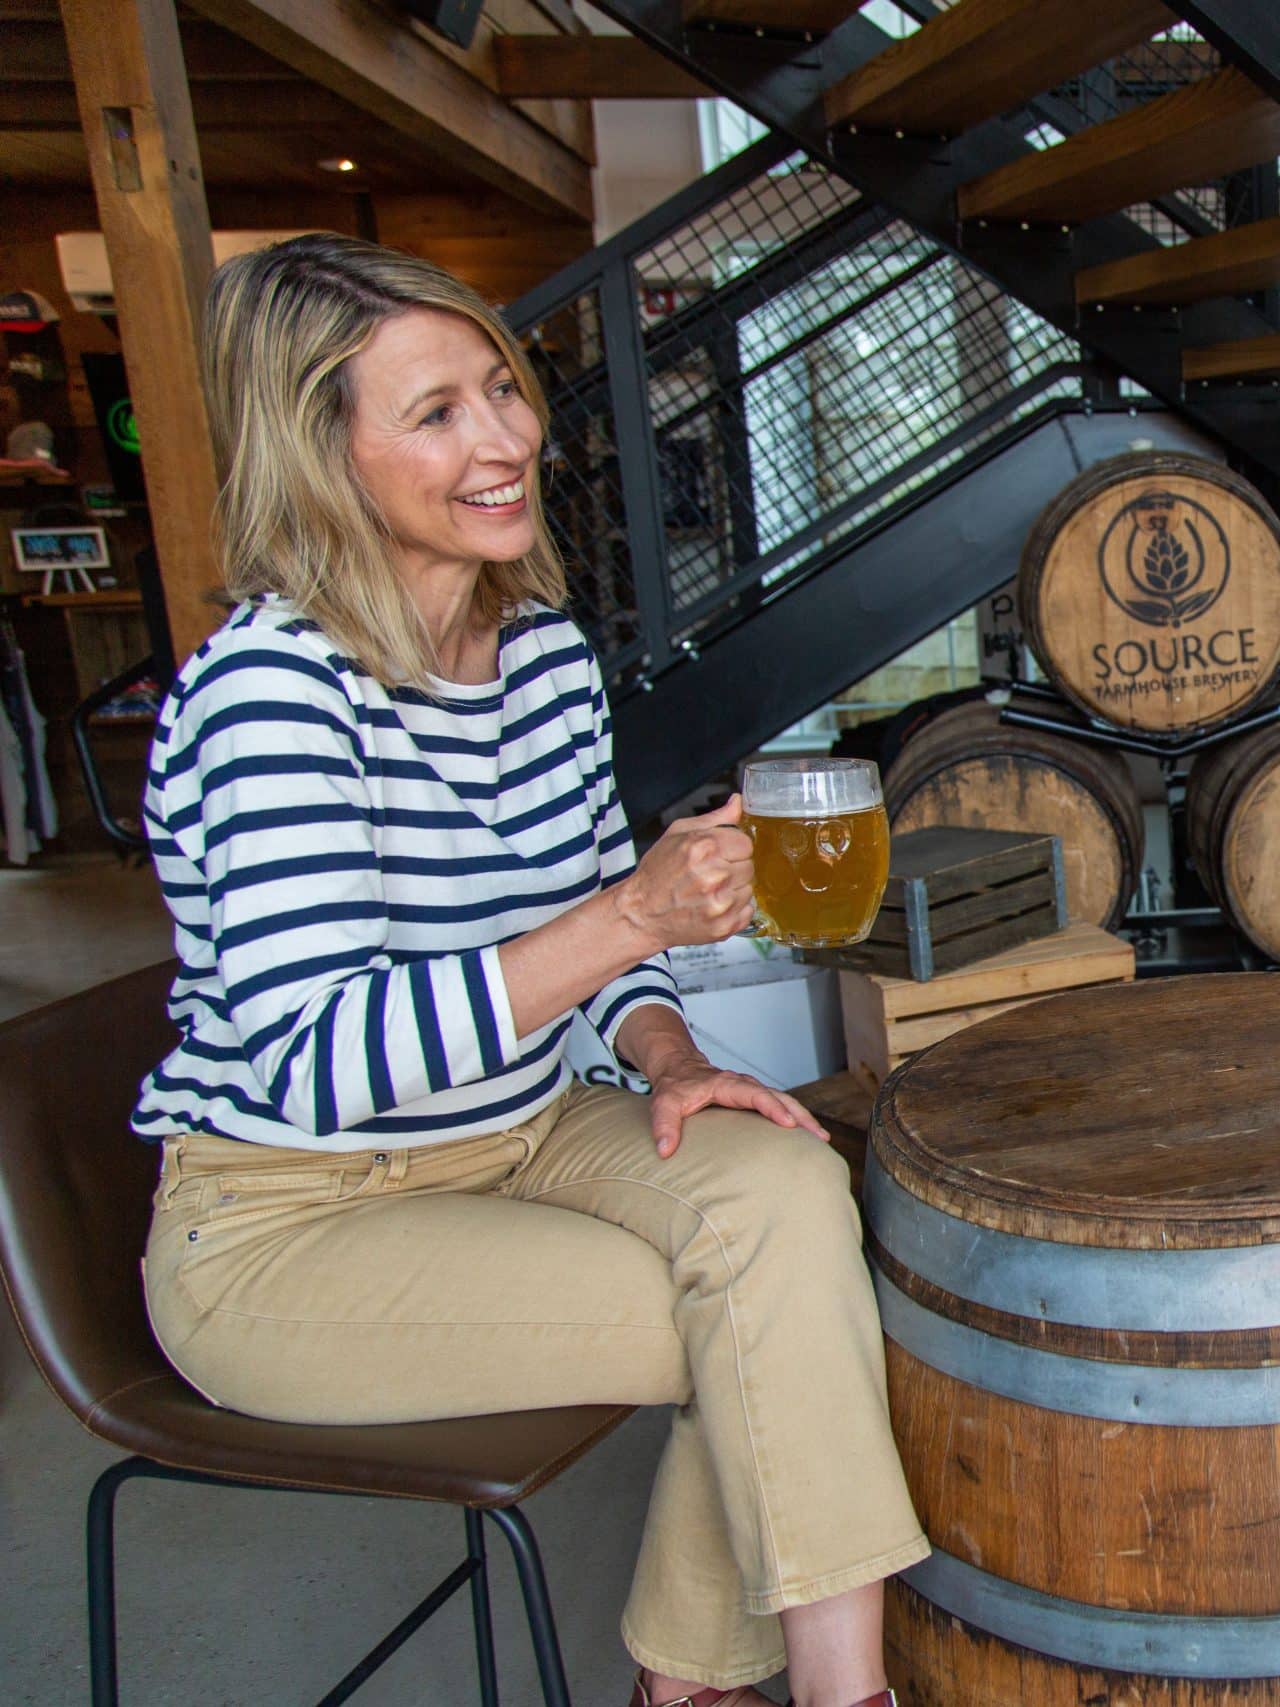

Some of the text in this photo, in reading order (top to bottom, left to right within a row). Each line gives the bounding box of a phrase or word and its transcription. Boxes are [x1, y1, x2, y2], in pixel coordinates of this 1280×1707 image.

[1092, 628, 1259, 679] SOURCE
[1094, 669, 1259, 699] FARMHOUSE BREWERY
